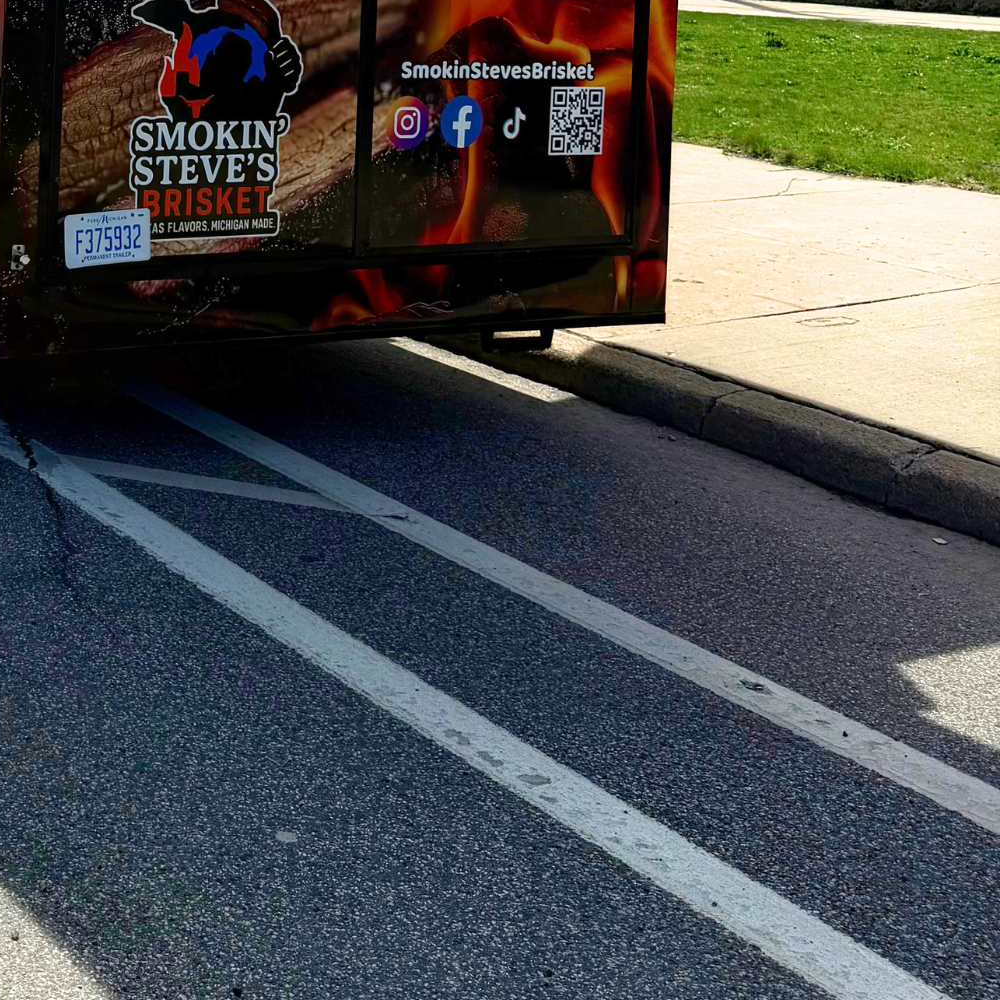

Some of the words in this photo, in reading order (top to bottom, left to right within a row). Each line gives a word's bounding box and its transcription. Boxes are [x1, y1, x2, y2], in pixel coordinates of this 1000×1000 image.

[401, 60, 595, 80] SmokinStevesBrisket
[135, 118, 286, 152] SMOKIN'
[134, 153, 275, 186] STEVE'S
[142, 186, 270, 218] BRISKET
[75, 224, 142, 255] F375932
[167, 220, 210, 233] FLAVORS.
[211, 218, 249, 231] MICHIGAN
[251, 217, 276, 229] MADE.
